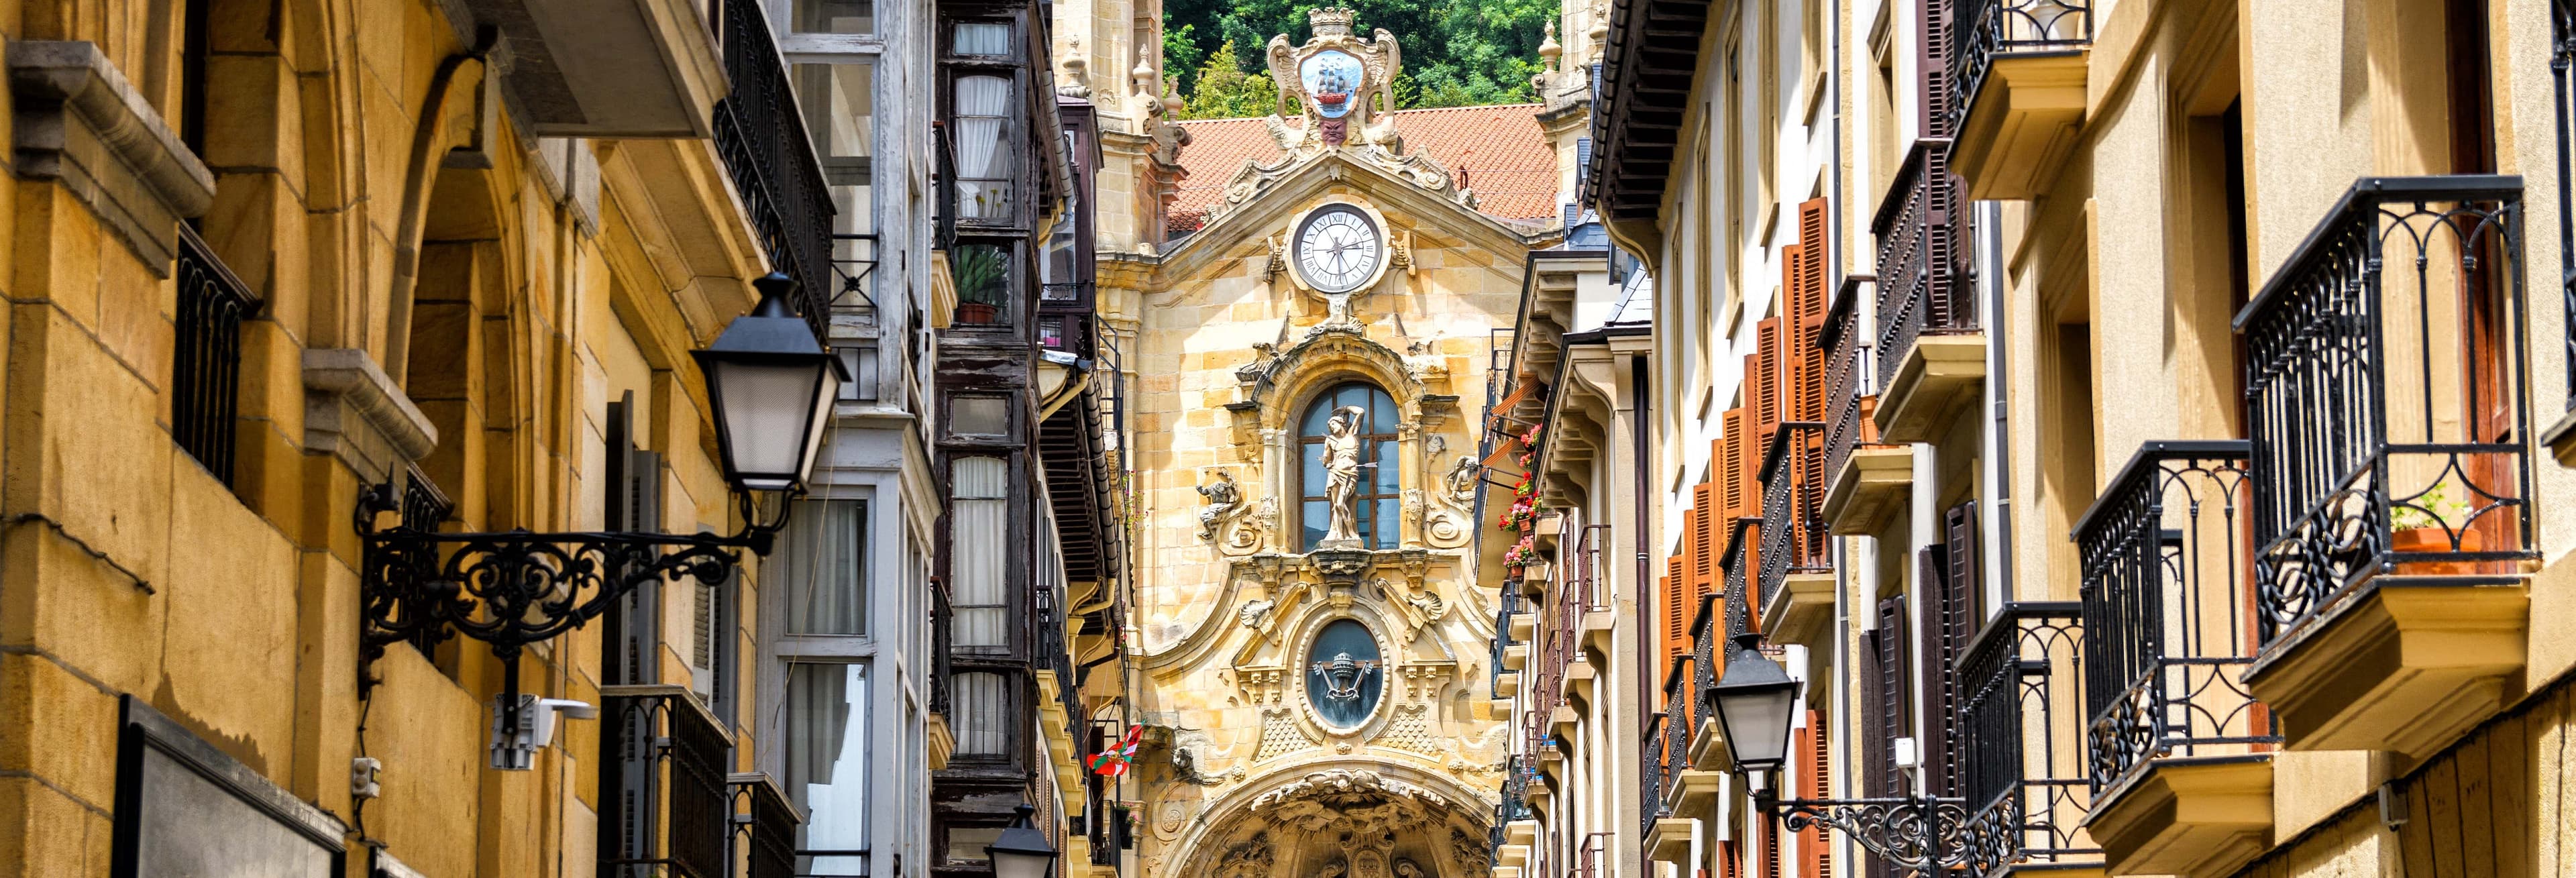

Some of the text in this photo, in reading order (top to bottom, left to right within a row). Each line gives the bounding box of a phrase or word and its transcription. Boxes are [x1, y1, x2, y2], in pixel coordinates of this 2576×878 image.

[1316, 218, 1327, 229] XI
[1332, 214, 1343, 223] XII
[1306, 230, 1316, 239] X
[1303, 245, 1311, 255] IX
[1305, 260, 1316, 273] VIII
